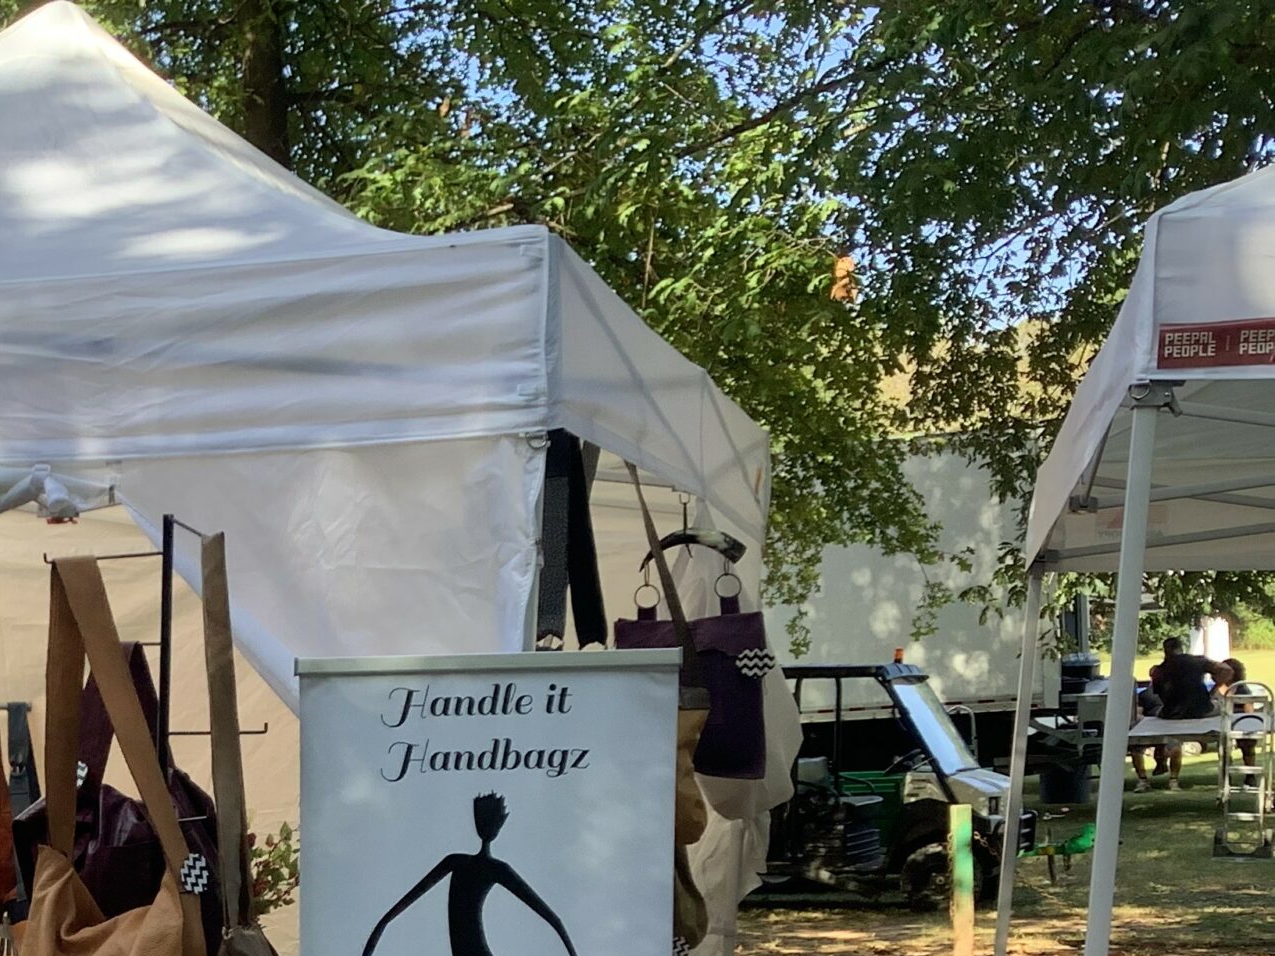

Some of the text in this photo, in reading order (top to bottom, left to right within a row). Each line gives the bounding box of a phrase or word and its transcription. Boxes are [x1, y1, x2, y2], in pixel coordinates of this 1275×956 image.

[1164, 344, 1216, 358] PEOPLE
[1165, 332, 1216, 345] PEEPAL
[380, 683, 574, 729] Handle it
[380, 738, 591, 783] Handbagz
